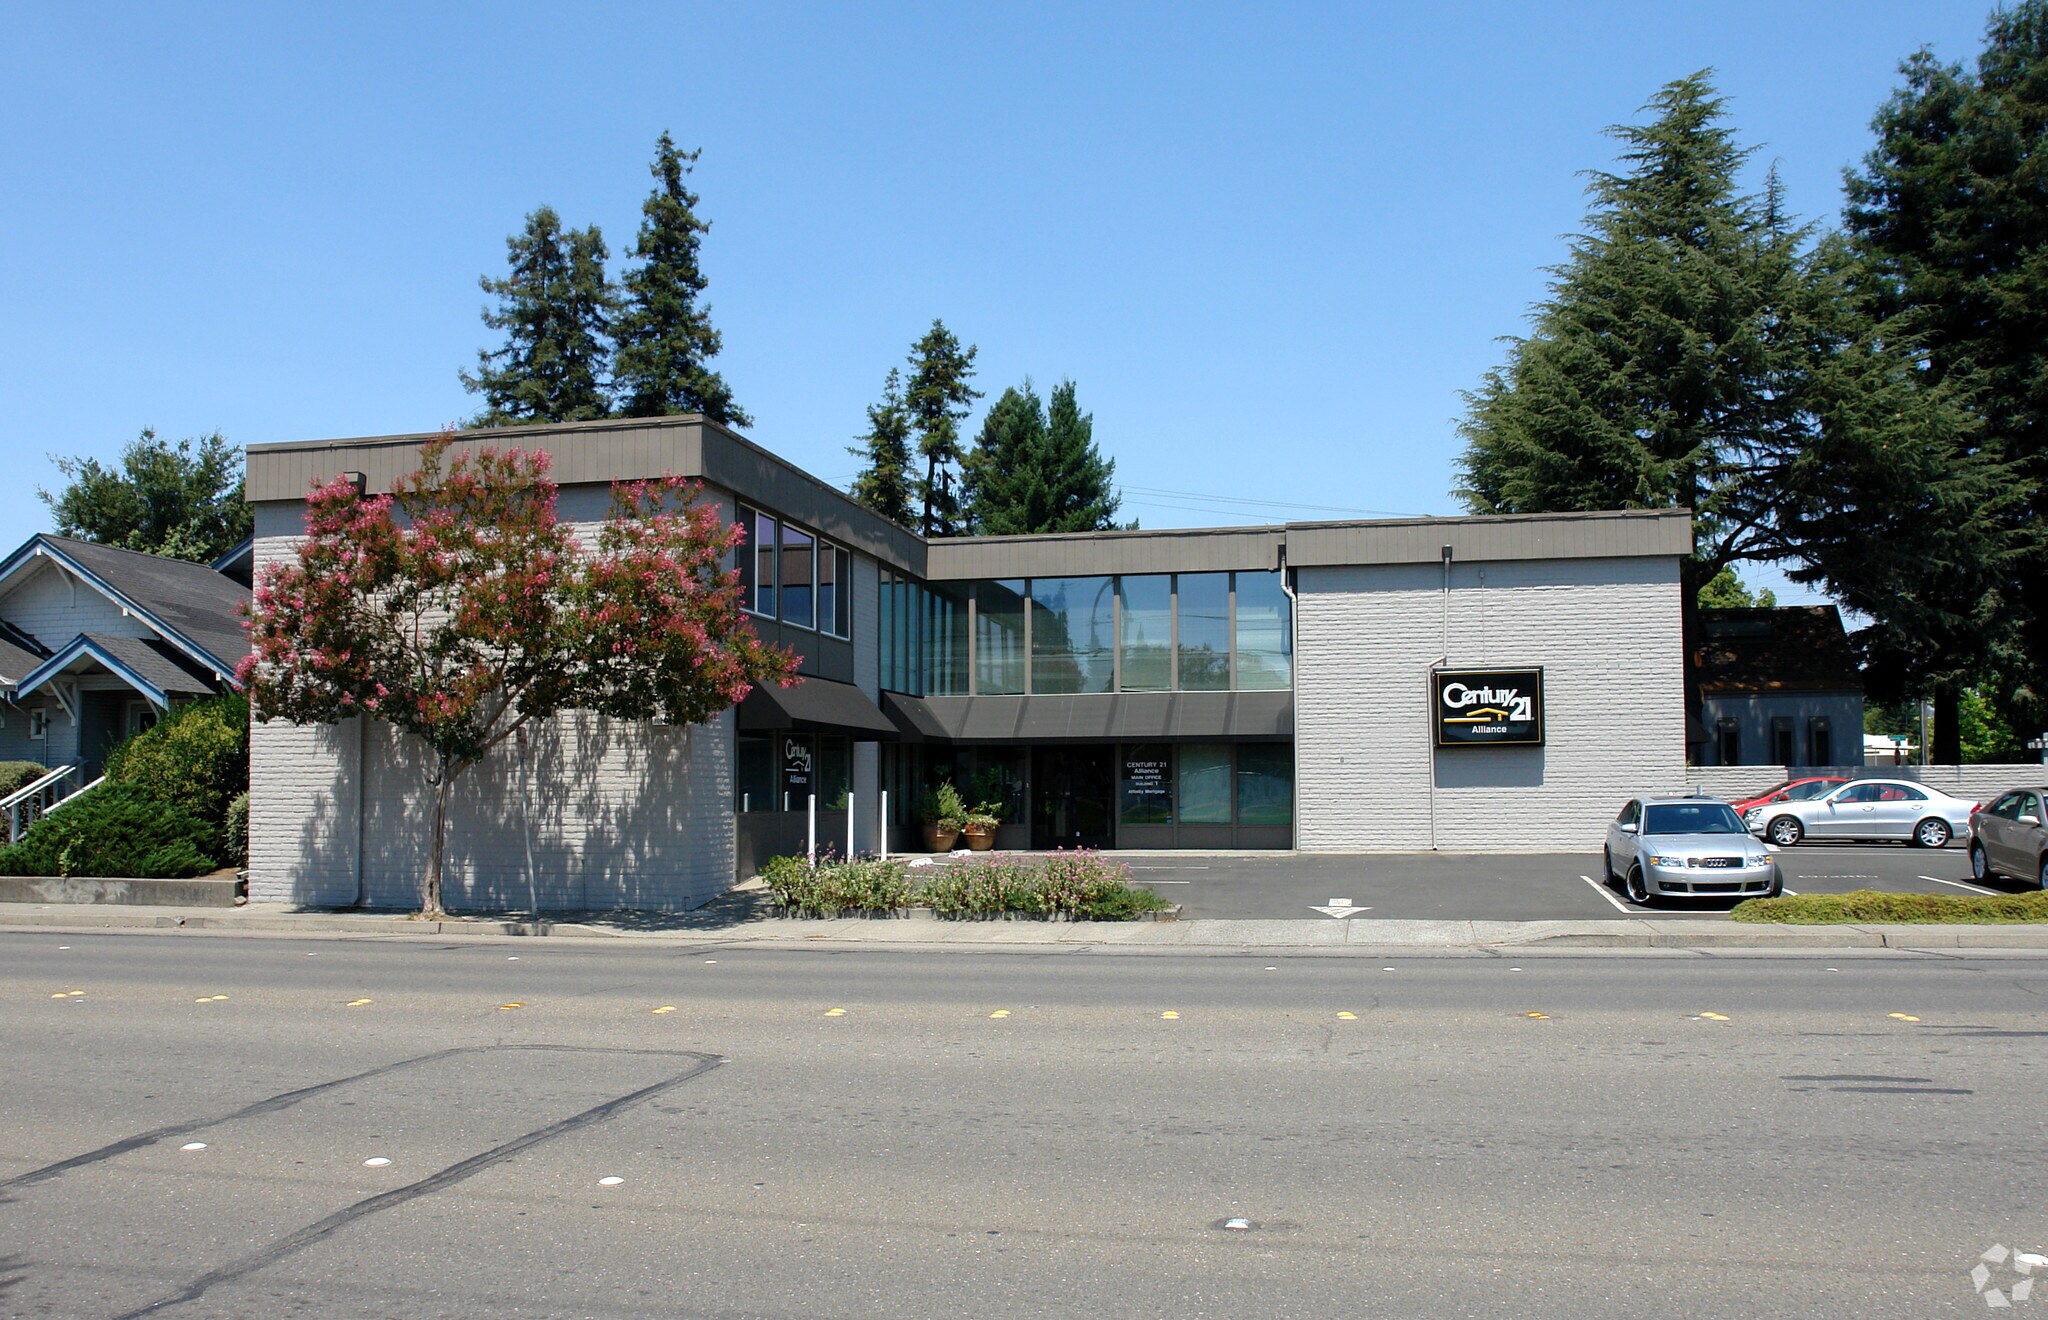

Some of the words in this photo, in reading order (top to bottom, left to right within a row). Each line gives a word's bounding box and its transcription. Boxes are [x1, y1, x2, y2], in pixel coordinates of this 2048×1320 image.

[1443, 683, 1518, 708] Century
[1509, 697, 1531, 721] 21
[785, 738, 807, 761] Century
[804, 754, 811, 772] 21
[789, 775, 807, 784] Alliance
